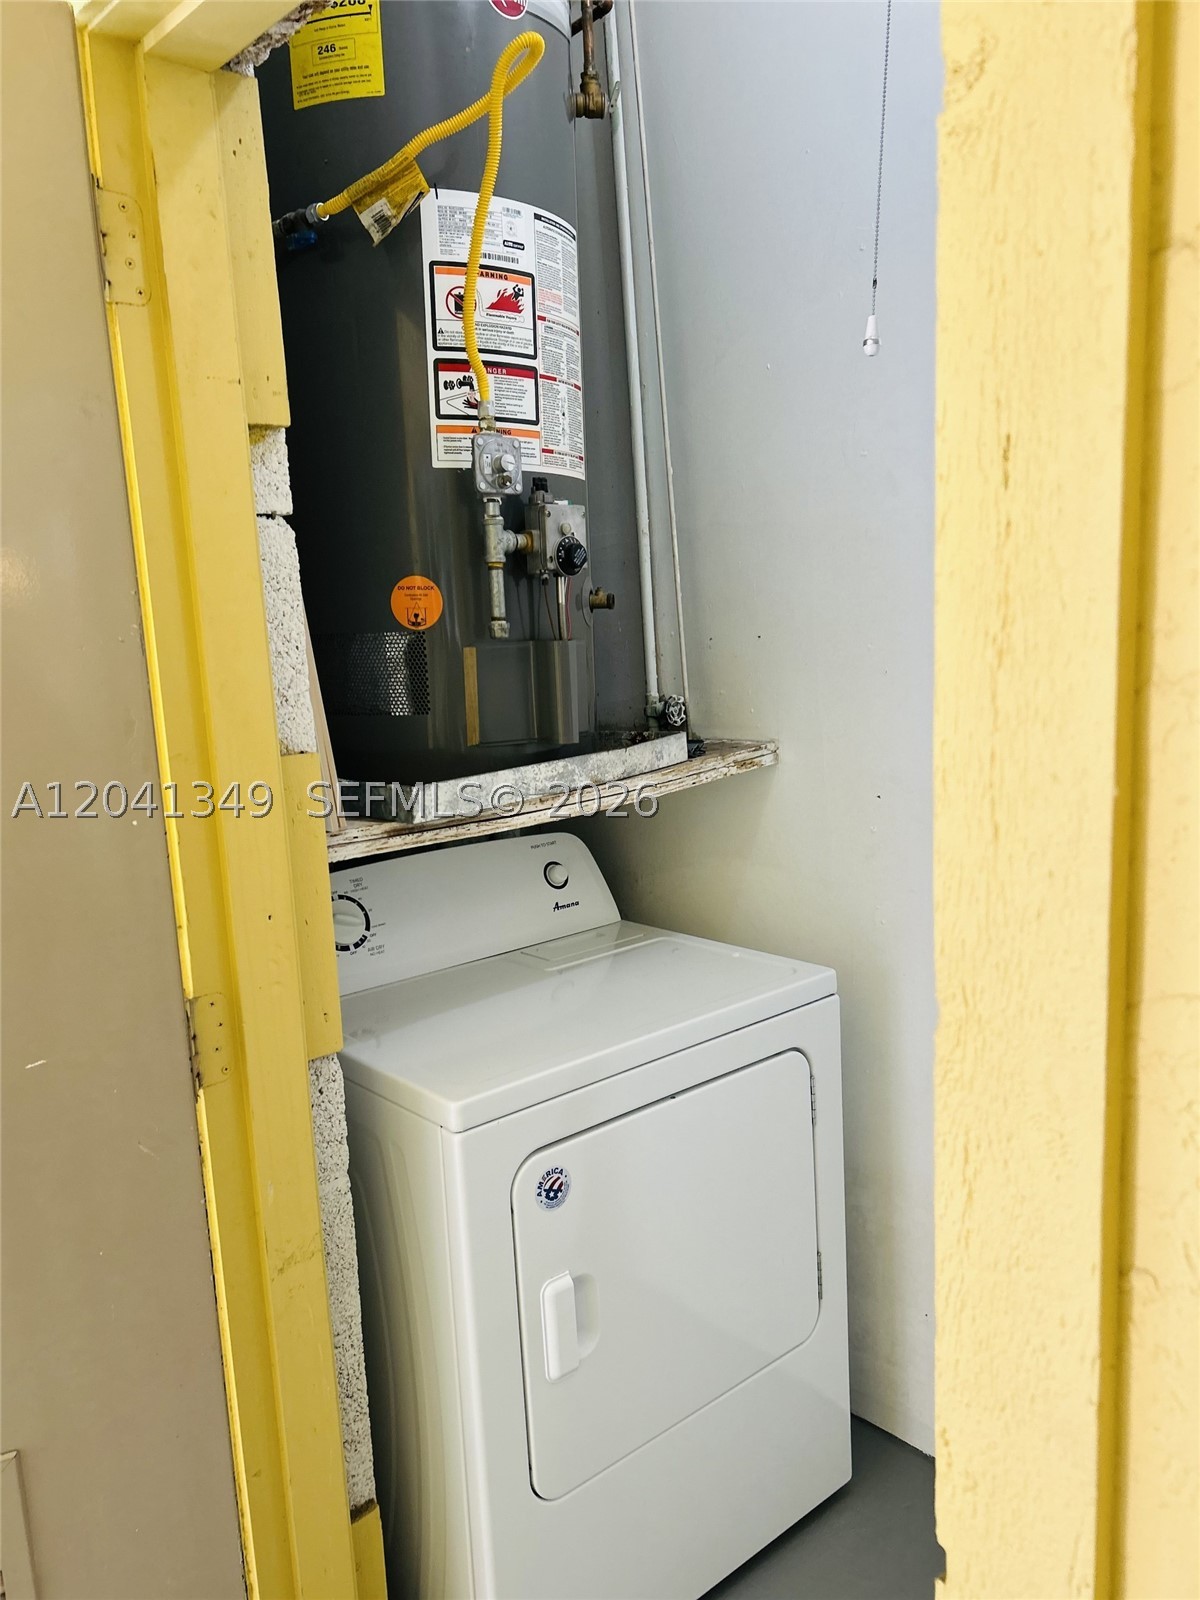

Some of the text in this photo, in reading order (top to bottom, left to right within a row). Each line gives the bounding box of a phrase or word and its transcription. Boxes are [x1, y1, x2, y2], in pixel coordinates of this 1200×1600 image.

[317, 44, 336, 55] 246
[487, 367, 507, 375] NGER
[553, 901, 579, 912] Amana
[537, 1167, 564, 1197] AMERICA
